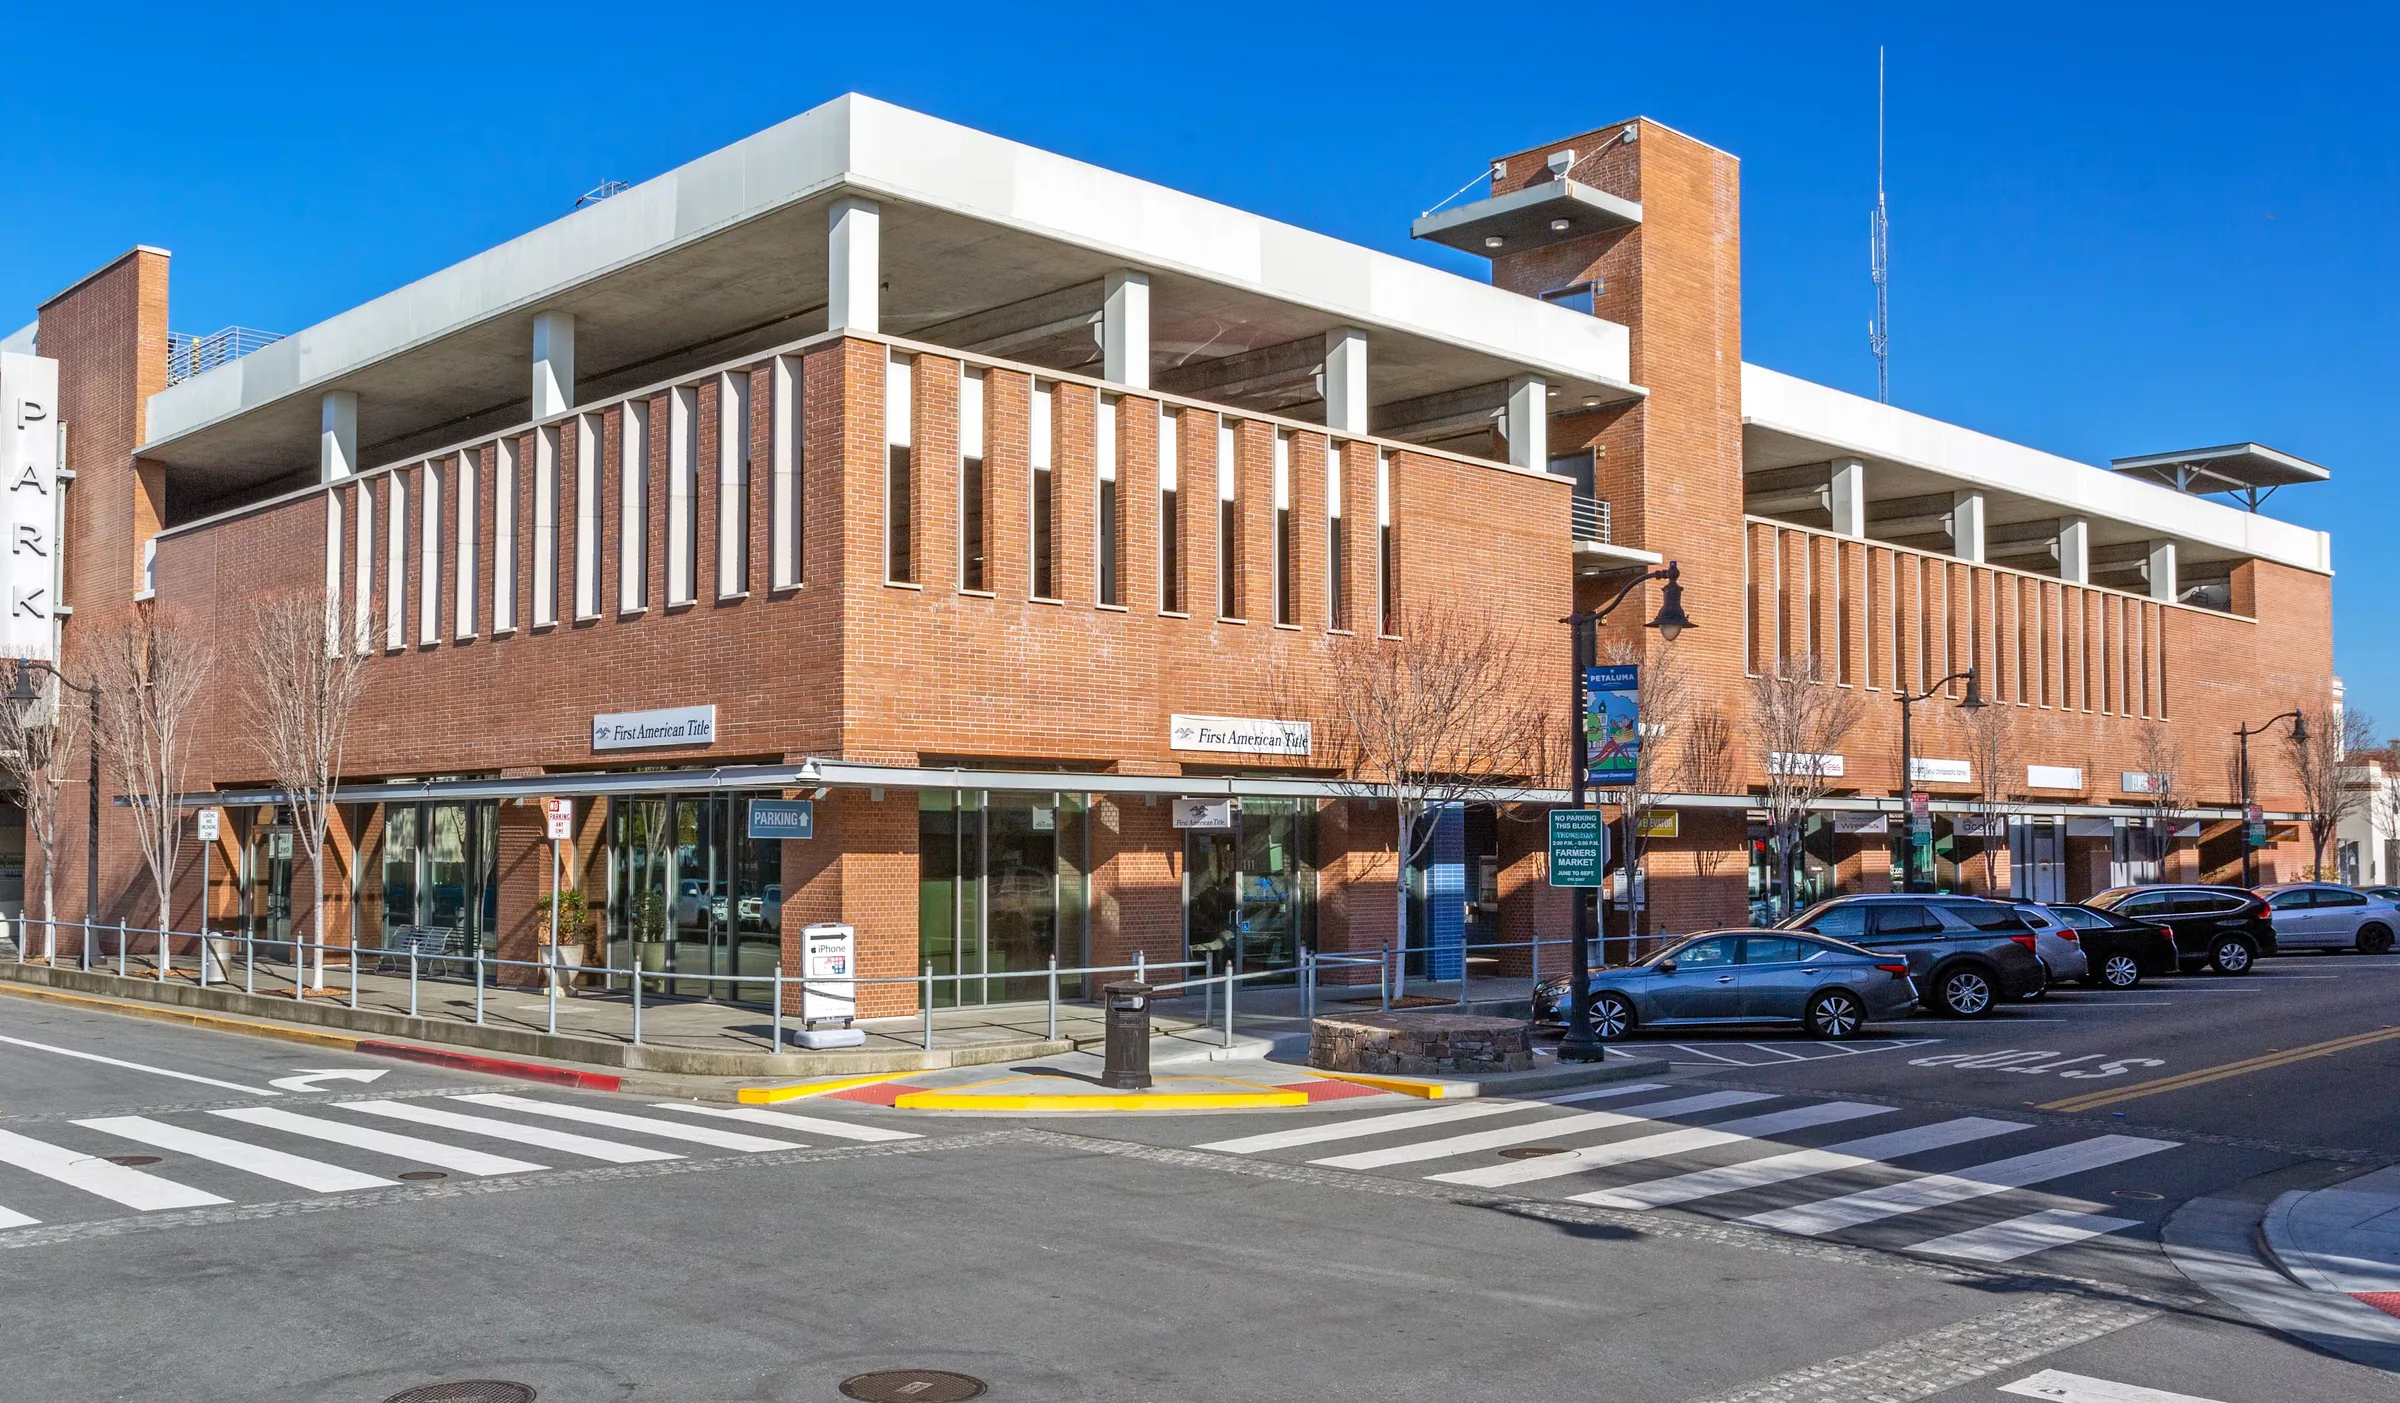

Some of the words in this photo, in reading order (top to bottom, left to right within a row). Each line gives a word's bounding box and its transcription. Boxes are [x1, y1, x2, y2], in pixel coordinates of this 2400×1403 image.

[10, 398, 48, 619] PARK
[1590, 673, 1635, 682] PETALUMA
[613, 725, 637, 741] First
[637, 722, 685, 739] American
[686, 719, 711, 736] Title
[1198, 727, 1226, 744] First
[1228, 730, 1282, 747] American
[550, 801, 559, 811] NO
[550, 813, 570, 821] PARKING
[754, 811, 798, 826] PARKING
[1840, 822, 1880, 830] Wireless
[1555, 849, 1597, 857] FARMERS
[818, 944, 846, 953] iPhone
